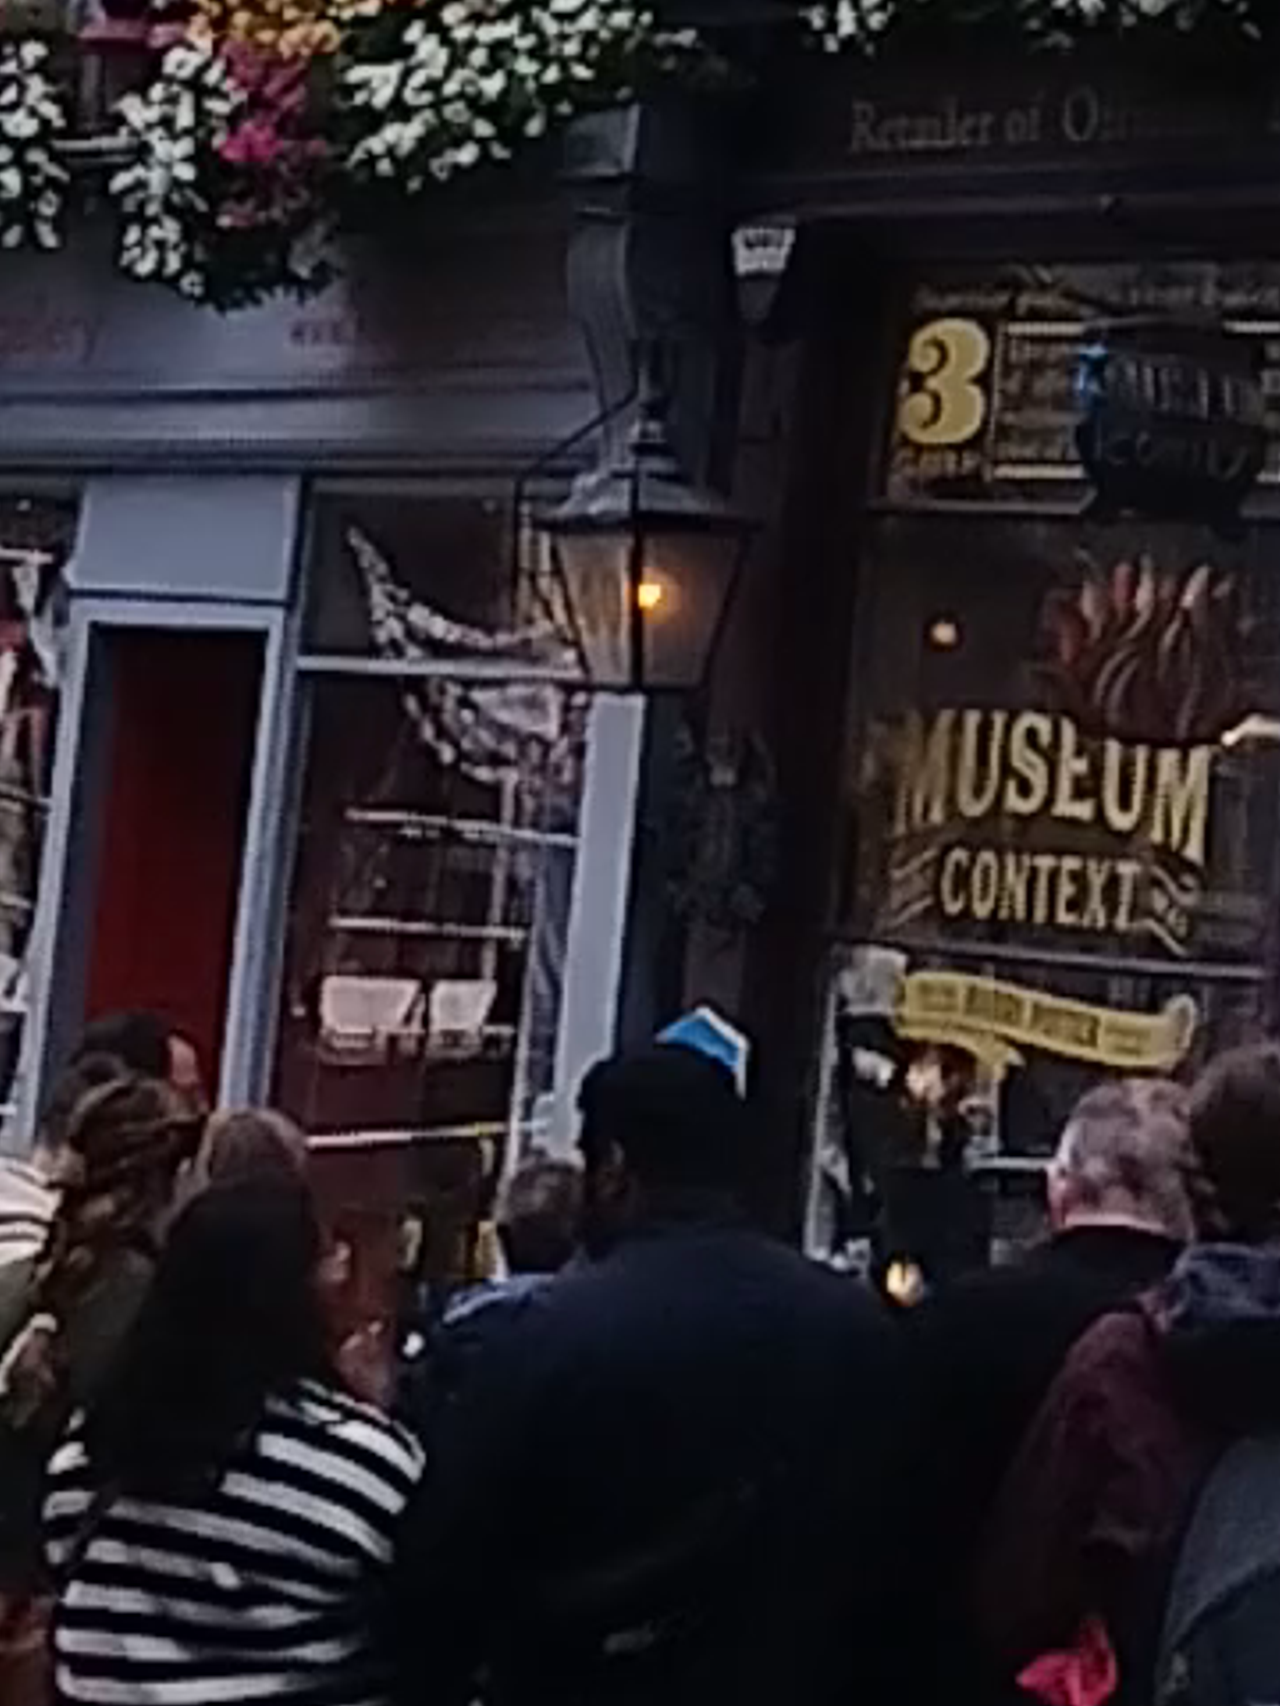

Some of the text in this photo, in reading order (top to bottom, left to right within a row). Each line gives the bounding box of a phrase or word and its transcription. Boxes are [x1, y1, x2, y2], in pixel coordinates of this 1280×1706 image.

[1003, 88, 1046, 144] of
[898, 316, 993, 448] 3
[892, 707, 1216, 868] MUSEUM
[939, 845, 1144, 932] CONTEXT
